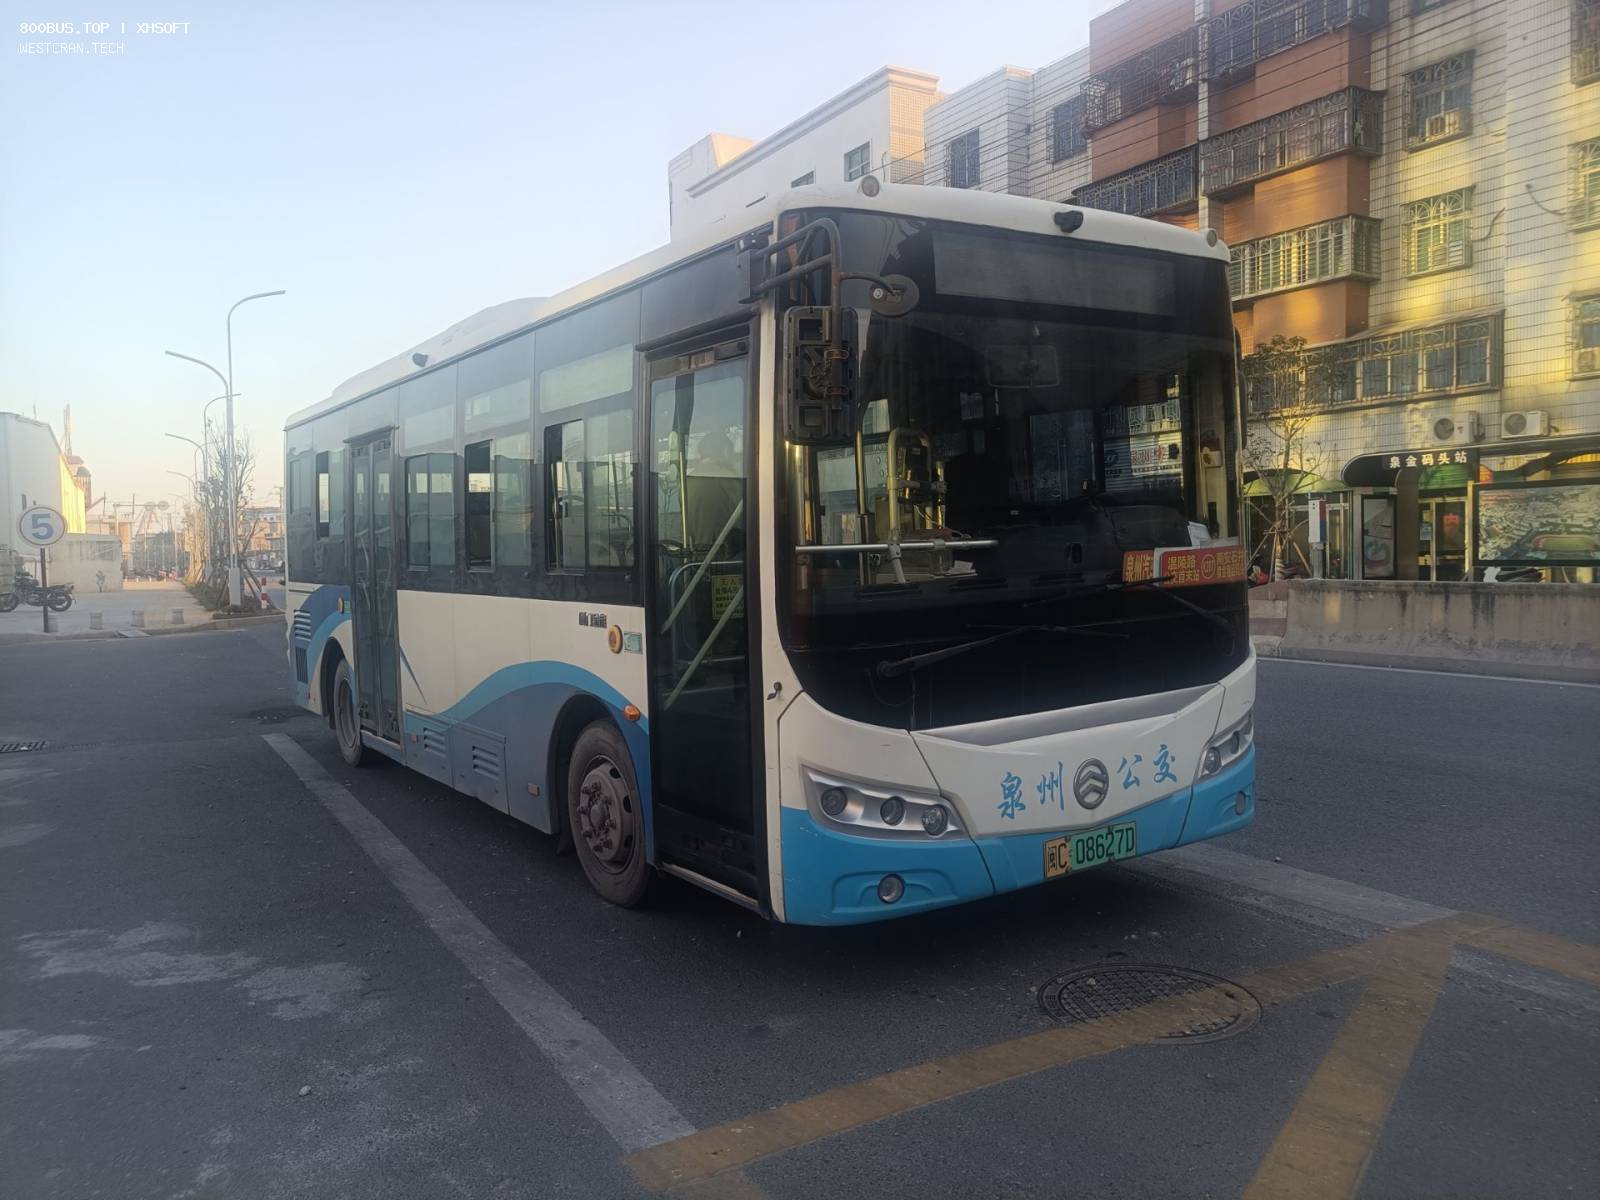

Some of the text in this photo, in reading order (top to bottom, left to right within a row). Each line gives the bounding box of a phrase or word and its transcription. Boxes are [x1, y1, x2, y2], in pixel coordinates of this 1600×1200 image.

[1389, 451, 1467, 469] 泉金码头站
[31, 513, 54, 540] 5
[997, 744, 1178, 820] 泉州 公交
